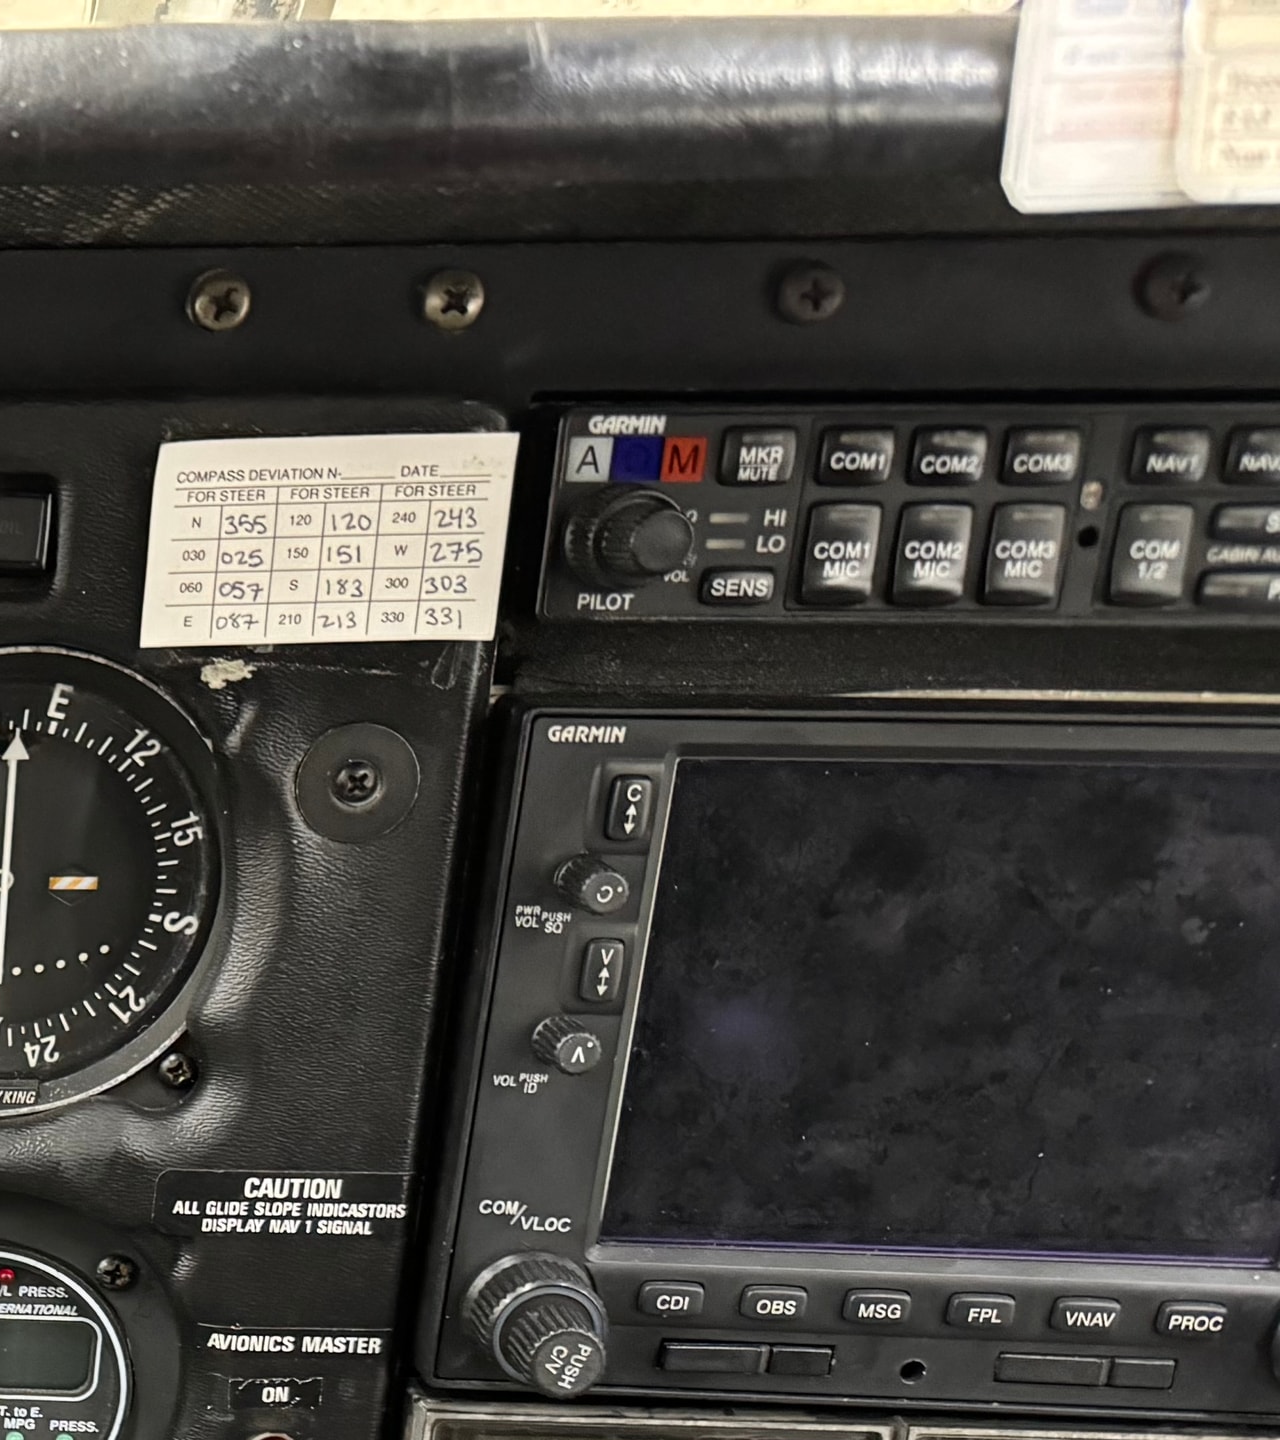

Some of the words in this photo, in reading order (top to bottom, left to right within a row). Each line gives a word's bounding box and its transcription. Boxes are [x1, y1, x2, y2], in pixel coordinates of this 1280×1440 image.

[588, 415, 667, 435] GARMIN
[575, 445, 600, 475] A
[668, 448, 699, 474] M
[176, 469, 246, 485] COMPASS
[247, 467, 324, 483] DEVIATION
[400, 464, 439, 478] DATE
[186, 490, 217, 503] FOR
[219, 488, 265, 502] STEER
[289, 488, 321, 500] FOR
[323, 486, 370, 499] STEER
[394, 484, 426, 498] FOR
[428, 483, 477, 497] STEER
[191, 516, 202, 529] N
[223, 514, 267, 535] 355
[289, 513, 312, 527] 120
[330, 513, 372, 533] 120
[392, 511, 416, 525] 240
[433, 505, 478, 529] 243
[763, 509, 787, 527] HI
[756, 535, 786, 554] LO
[710, 579, 769, 598] SENS
[576, 593, 635, 611] PILOT
[547, 725, 627, 744] GARMIN
[243, 1177, 343, 1200] CAUTION
[172, 1200, 200, 1217] ALL
[205, 1200, 249, 1217] GLIDE
[253, 1202, 303, 1218] SLOPE
[306, 1202, 406, 1220] INDICASTORS
[200, 1218, 264, 1234] DISPLAY
[269, 1219, 302, 1235] NAV
[304, 1220, 312, 1234] 1
[316, 1220, 372, 1236] SIGNAL
[18, 1286, 69, 1298] PRESS.
[655, 1293, 691, 1313] CDI
[755, 1296, 797, 1317] OBS
[857, 1300, 902, 1321] MSG
[967, 1305, 1003, 1324] FPL
[1064, 1308, 1116, 1328] VNAV
[1168, 1312, 1224, 1334] PROC
[206, 1332, 295, 1353] AVIONICS
[301, 1336, 383, 1355] MASTER
[261, 1387, 289, 1403] ON
